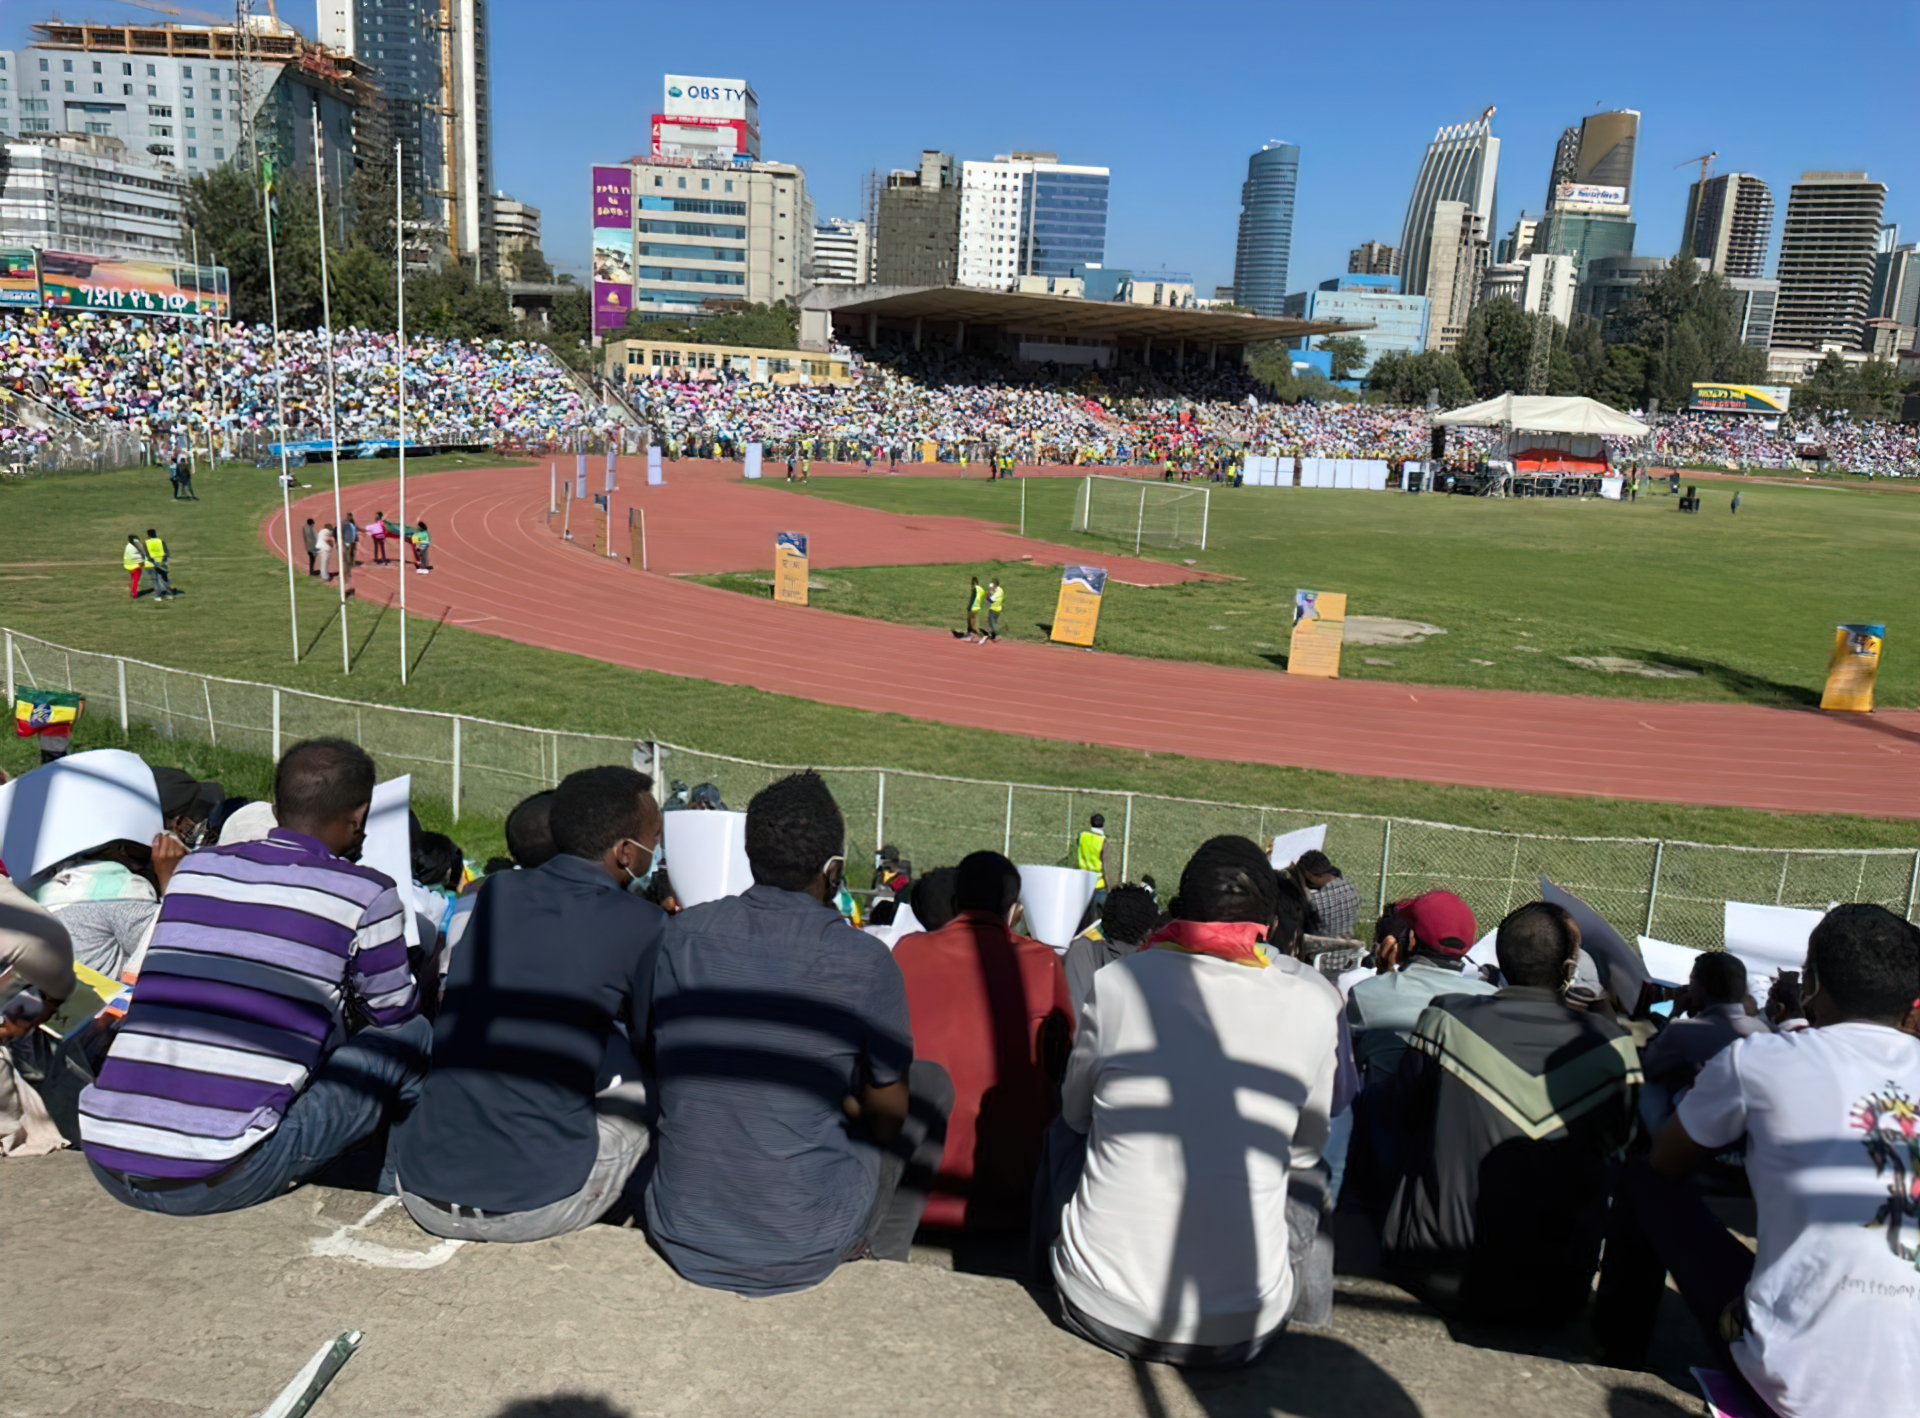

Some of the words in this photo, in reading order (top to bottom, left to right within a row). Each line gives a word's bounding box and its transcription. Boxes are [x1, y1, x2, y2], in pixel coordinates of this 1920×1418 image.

[687, 85, 719, 100] OBS
[724, 88, 745, 101] TV
[158, 291, 189, 313] ነው
